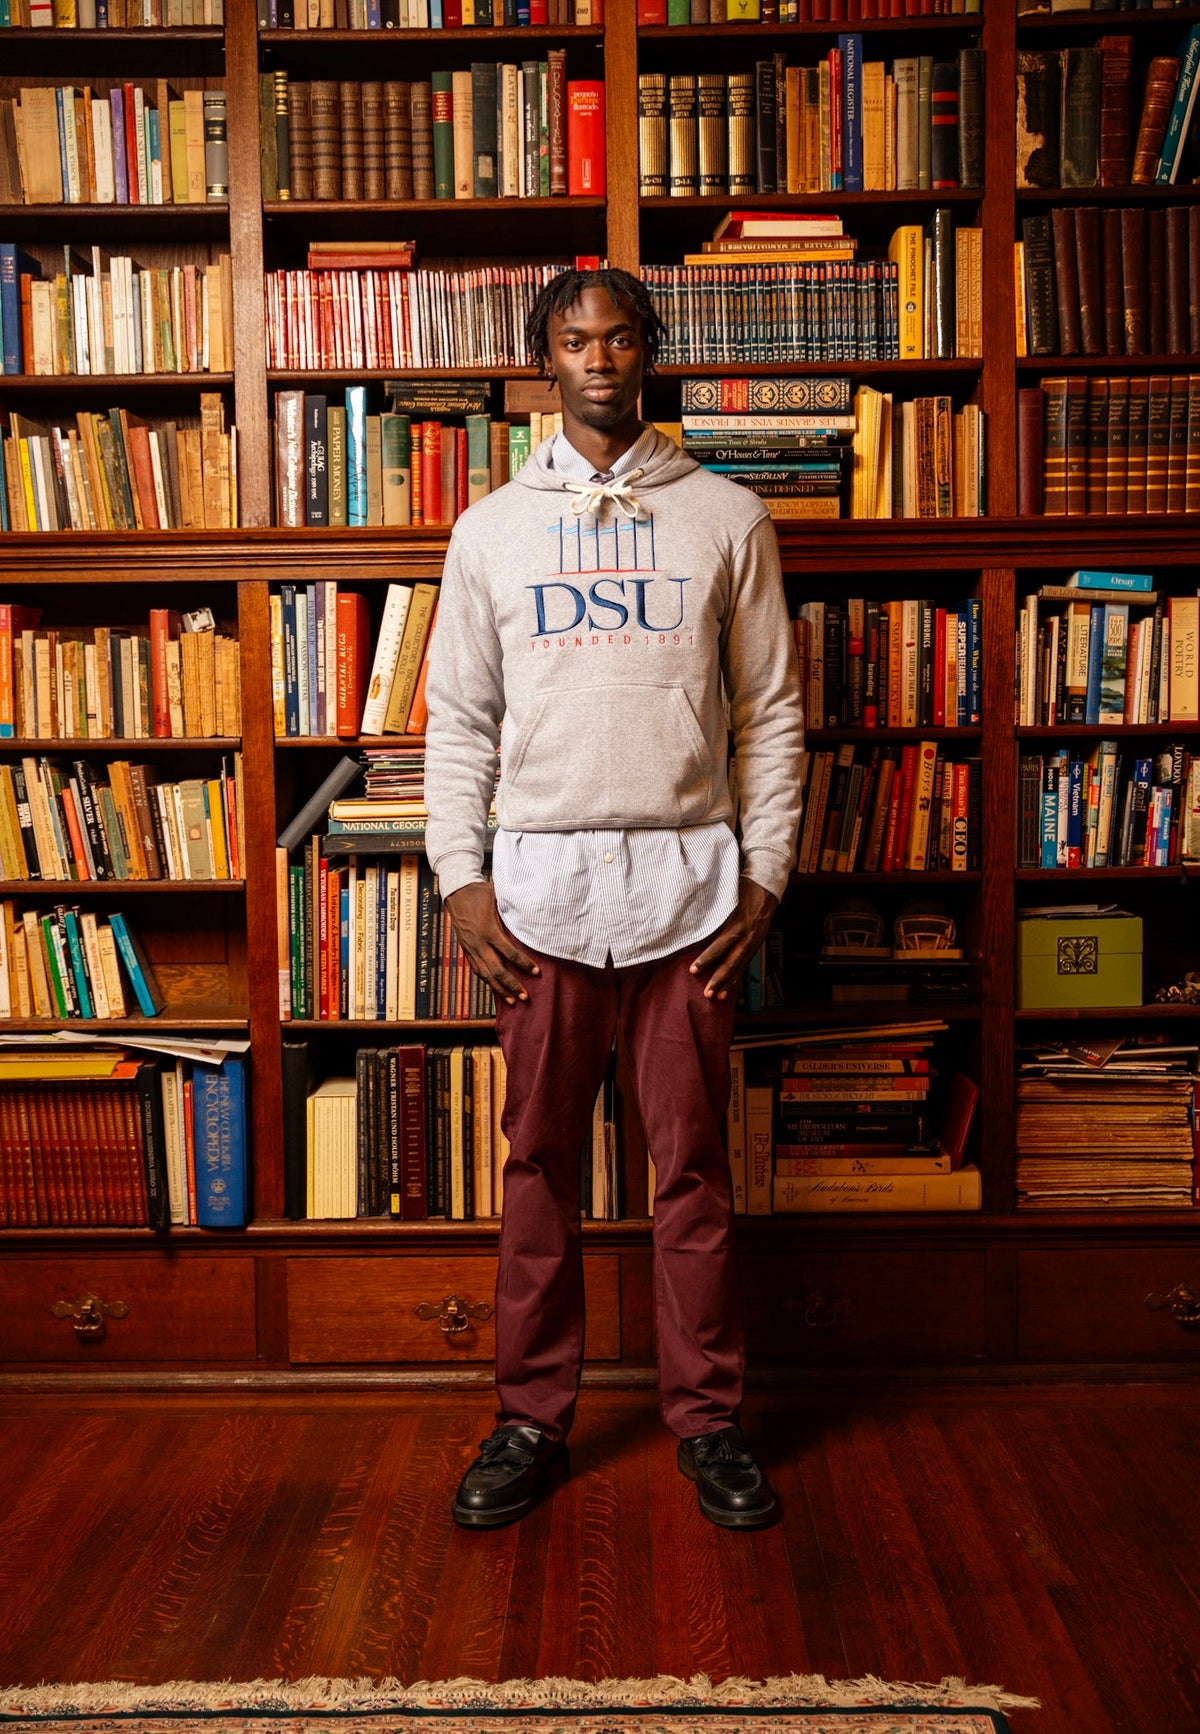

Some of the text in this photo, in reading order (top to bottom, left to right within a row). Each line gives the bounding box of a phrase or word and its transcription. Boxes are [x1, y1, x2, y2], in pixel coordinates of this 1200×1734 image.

[847, 38, 856, 120] NATIONAL REGISTER
[1177, 37, 1199, 103] Silverplated Flatware
[507, 68, 515, 109] PLAYERS
[572, 91, 600, 99] pequeño
[64, 109, 73, 140] NAVIDAD
[572, 103, 600, 112] ilustrado
[68, 141, 75, 152] DE
[138, 137, 145, 150] EN
[727, 241, 834, 251] TALLER DE MANUALIDADES
[691, 417, 837, 427] LES GRANDS VINS DE FRANCE
[286, 398, 298, 527] Webster's New Collegiate Dictionary
[309, 440, 318, 477] Archipelago
[317, 446, 325, 472] GULAG
[332, 427, 341, 502] PAPER MONEY
[715, 449, 759, 459] Of Houses &
[749, 472, 789, 480] ANTIQUES
[774, 485, 814, 493] DEFINED
[1110, 576, 1135, 588] Orsay
[524, 577, 692, 637] DSU
[390, 606, 407, 673] ELEMENTS
[530, 634, 695, 652] FOUNDED 1891
[923, 608, 932, 648] INFONOMICS
[1057, 623, 1068, 663] JAY-Z
[1109, 623, 1122, 637] 500
[272, 640, 281, 668] Antiques
[398, 641, 412, 675] OF DOLLS
[398, 606, 428, 714] THE COLLECTORS ENCYCLOPEDIA
[957, 621, 967, 697] SUPERFREAKONOMICS
[970, 603, 979, 692] How you What you do
[1078, 624, 1088, 677] LITERATURE
[1162, 655, 1168, 665] OF
[1174, 639, 1185, 678] POETRY
[1185, 630, 1194, 678] WORLD
[338, 632, 347, 709] ORIENTAL RUGS
[812, 657, 823, 681] four
[865, 663, 875, 697] branding
[891, 622, 900, 710] SMART LUCKY?
[908, 650, 916, 711] STARTUPS THAT WORK
[922, 760, 934, 793] Boys
[1022, 763, 1039, 772] PARIS
[1172, 746, 1184, 784] LONDON
[131, 771, 142, 807] LATIN
[943, 770, 951, 799] LEADING
[958, 769, 967, 817] THE ROAD TO
[1071, 783, 1081, 816] Vietnam
[1136, 781, 1149, 812] Brazil
[82, 796, 94, 825] SILVER
[342, 821, 427, 831] NATIONAL GEOGRA
[1044, 795, 1056, 842] MAINE
[873, 805, 888, 855] TRADING UP
[887, 826, 896, 858] OPPORTUNITY
[954, 817, 967, 856] CEO
[1162, 817, 1170, 841] French
[356, 883, 364, 920] Decorating
[367, 883, 375, 923] OUTDOOR
[405, 859, 415, 932] PERIOD ROOMS
[57, 907, 67, 929] Zorro
[305, 871, 313, 992] AND CARPETS THE ORIENT
[389, 917, 397, 931] Europe
[330, 931, 338, 957] Jewelry
[367, 924, 375, 951] ROOM
[379, 934, 387, 973] inspirations
[330, 960, 338, 986] Designs
[801, 1062, 891, 1071] CALDER'S UNIVERSE
[205, 1074, 220, 1172] ENCYCLOPEDIA
[219, 1075, 232, 1172] THE NEW COLUMBIA
[381, 1163, 389, 1180] JAZZ
[753, 1133, 770, 1187] Politics
[808, 1181, 895, 1193] Audubon's Birds
